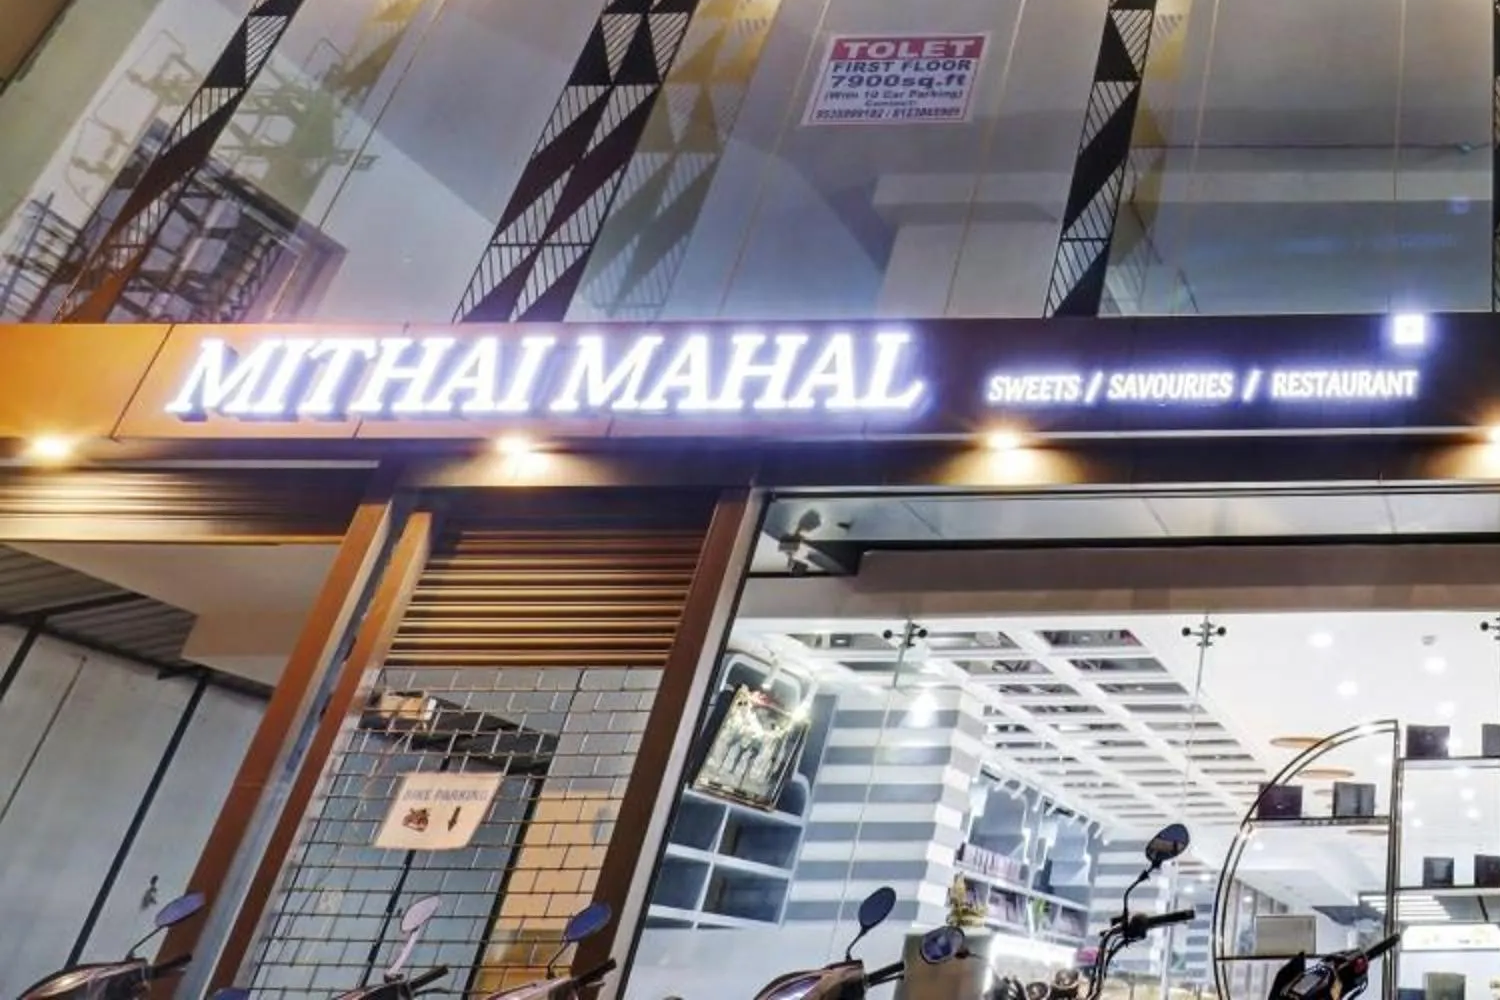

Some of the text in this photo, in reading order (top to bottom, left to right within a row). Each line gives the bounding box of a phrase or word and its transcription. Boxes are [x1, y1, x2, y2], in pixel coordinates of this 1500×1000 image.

[832, 60, 972, 73] FIRST FLOOR
[830, 74, 967, 89] 7900sq.ft
[882, 90, 904, 99] Car
[908, 89, 964, 100] Parking)
[165, 331, 925, 416] MITHAI MAHAL
[986, 374, 1082, 402] SWEETS
[1107, 371, 1233, 400] SAVOURIES
[1272, 369, 1418, 398] RESTAURANT
